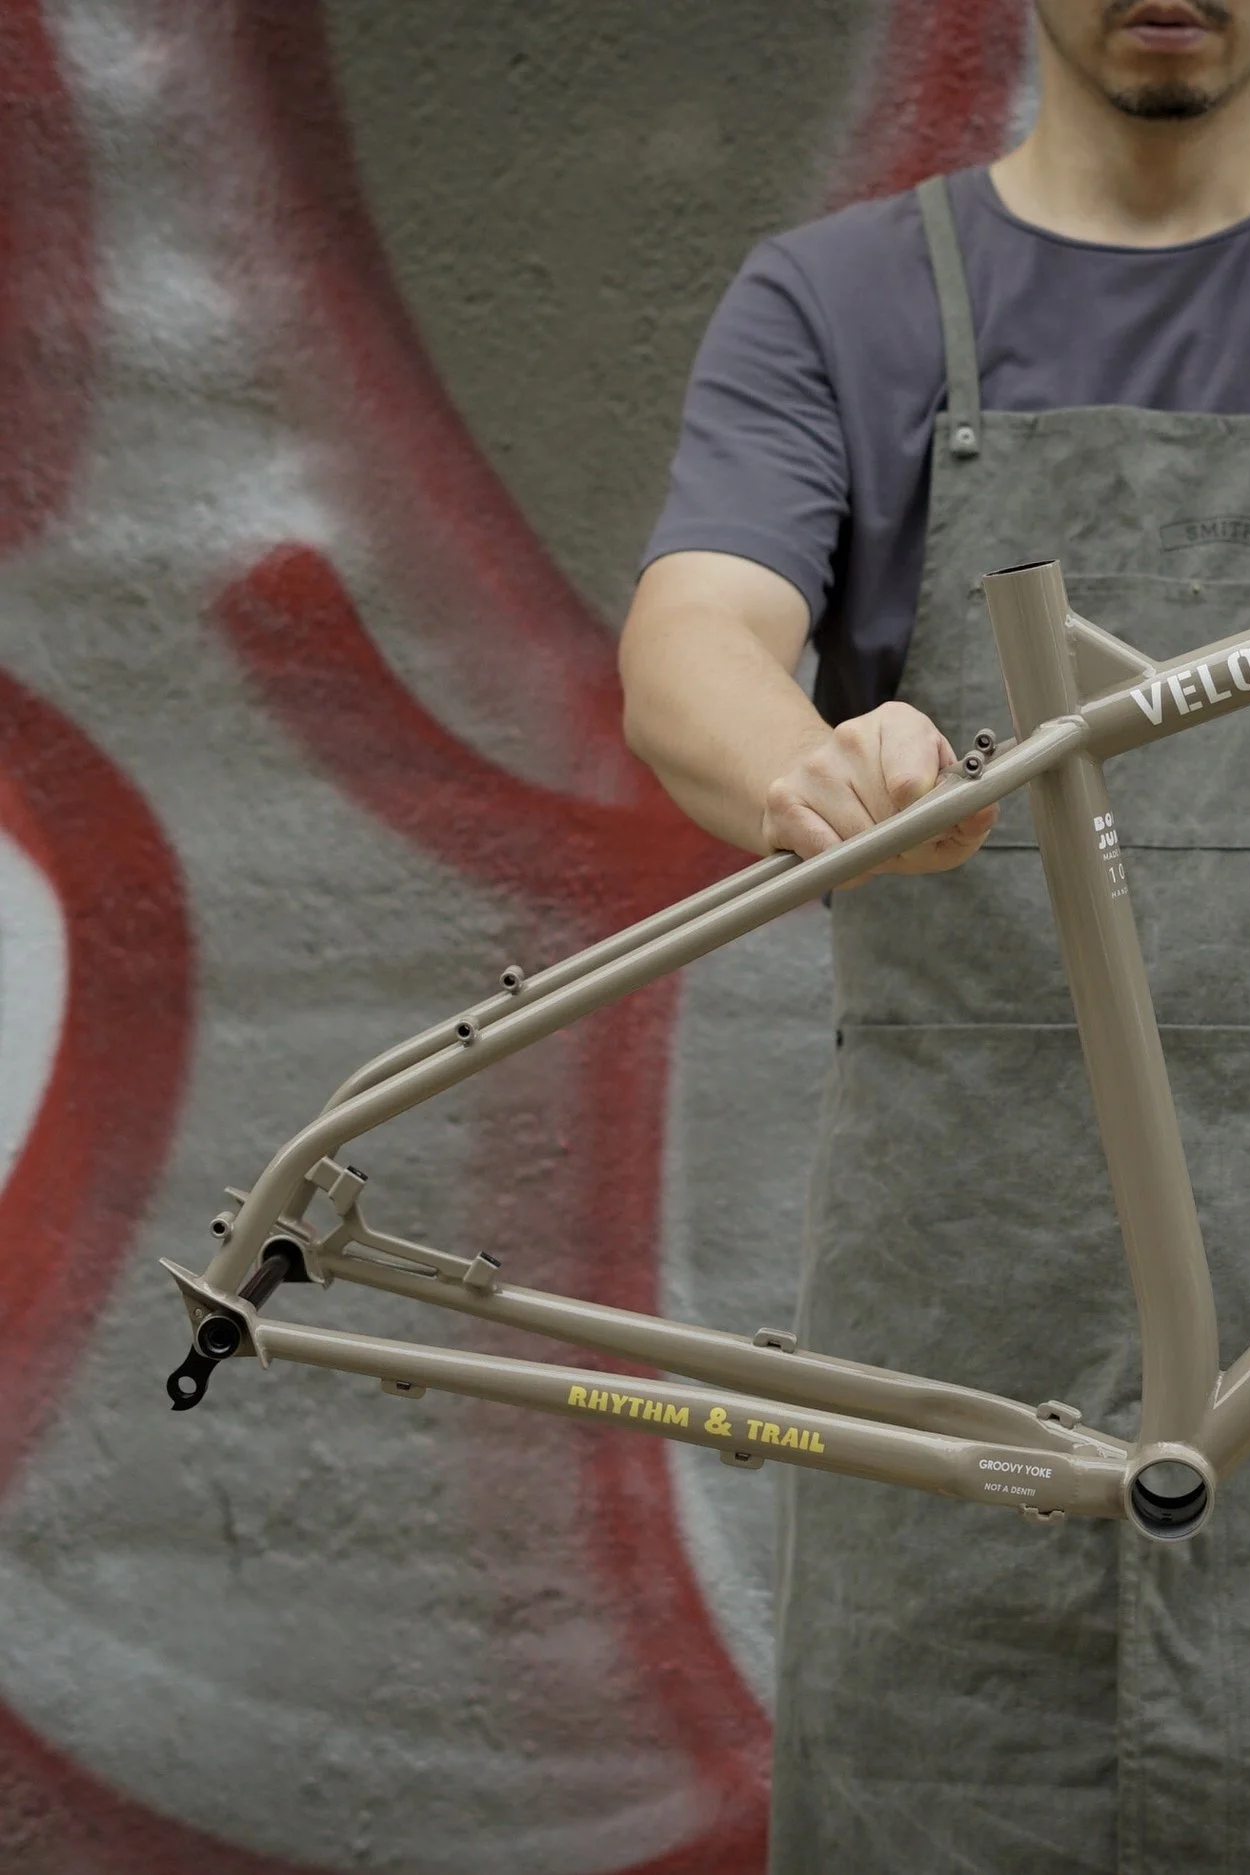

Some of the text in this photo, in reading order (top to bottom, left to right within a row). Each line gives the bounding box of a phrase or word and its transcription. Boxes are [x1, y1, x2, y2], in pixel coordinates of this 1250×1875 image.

[1093, 811, 1114, 831] BO
[567, 1385, 825, 1453] RHYTHM & TRAIL
[979, 1459, 1052, 1478] GROOVY YOKE
[984, 1482, 1001, 1492] NOT
[1002, 1485, 1009, 1493] A
